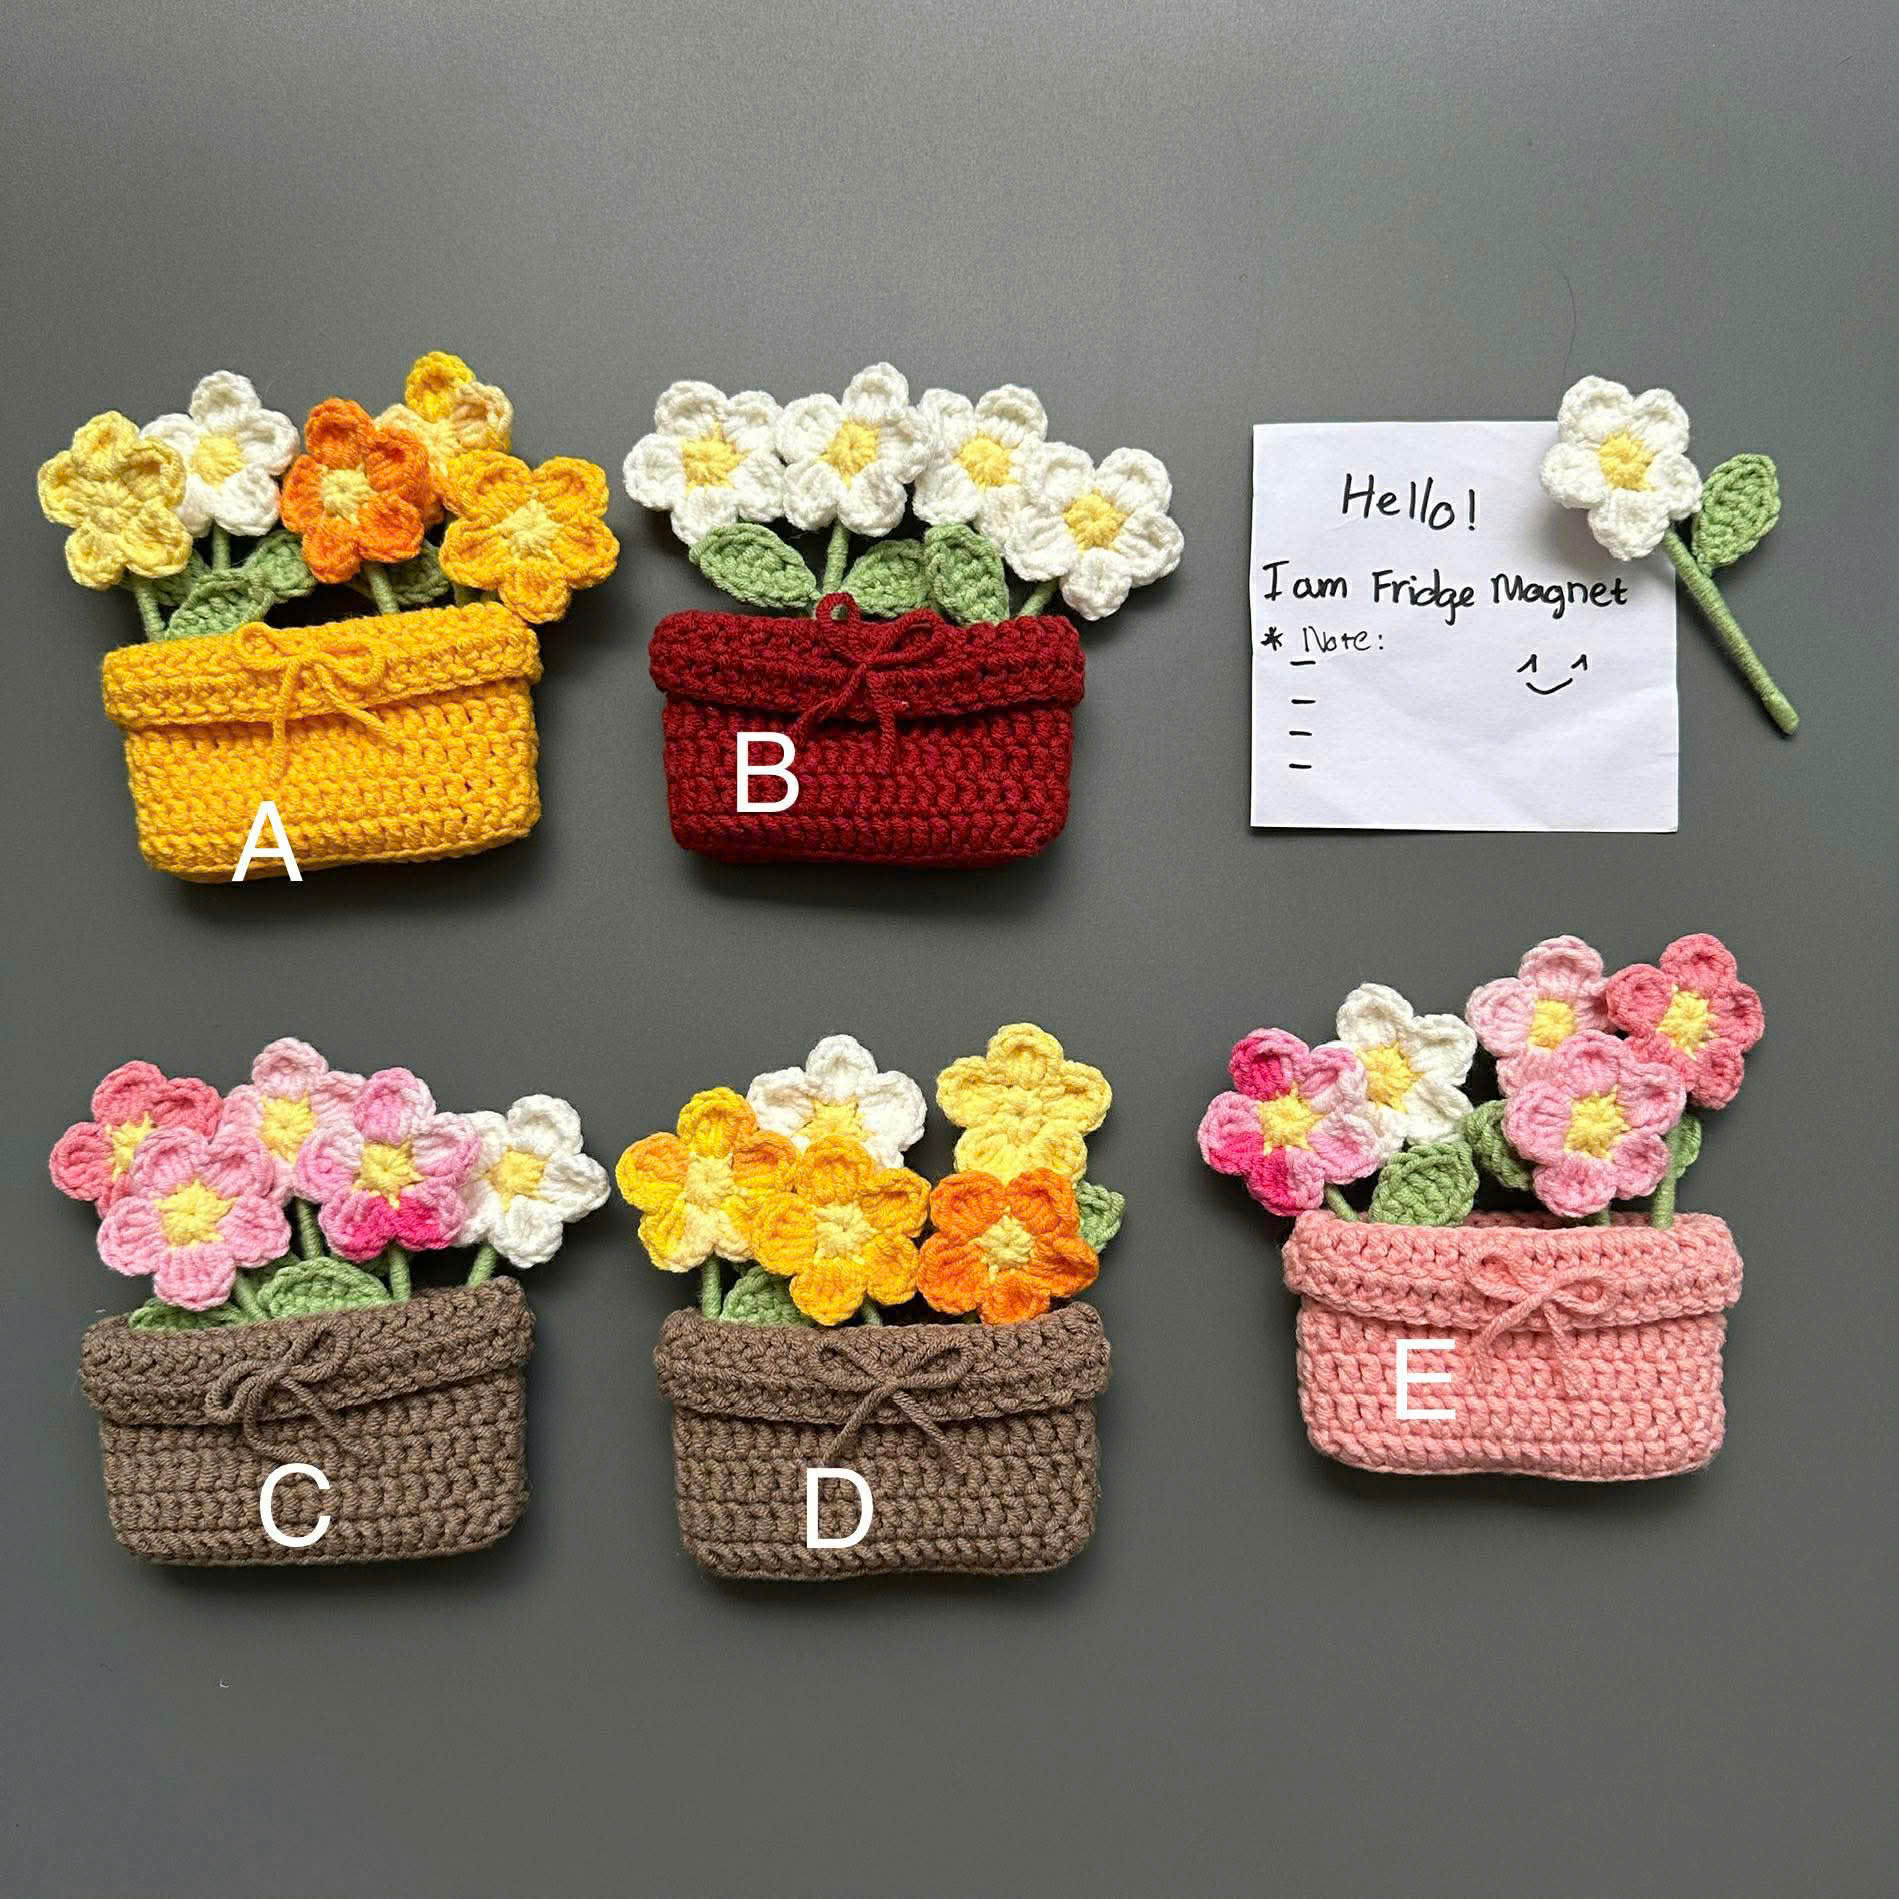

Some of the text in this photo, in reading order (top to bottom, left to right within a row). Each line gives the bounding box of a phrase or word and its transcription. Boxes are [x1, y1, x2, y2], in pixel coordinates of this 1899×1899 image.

[1342, 473, 1476, 532] Hello!
[1262, 560, 1629, 626] I am Fridge Magnet
[1302, 625, 1385, 653] Note:
